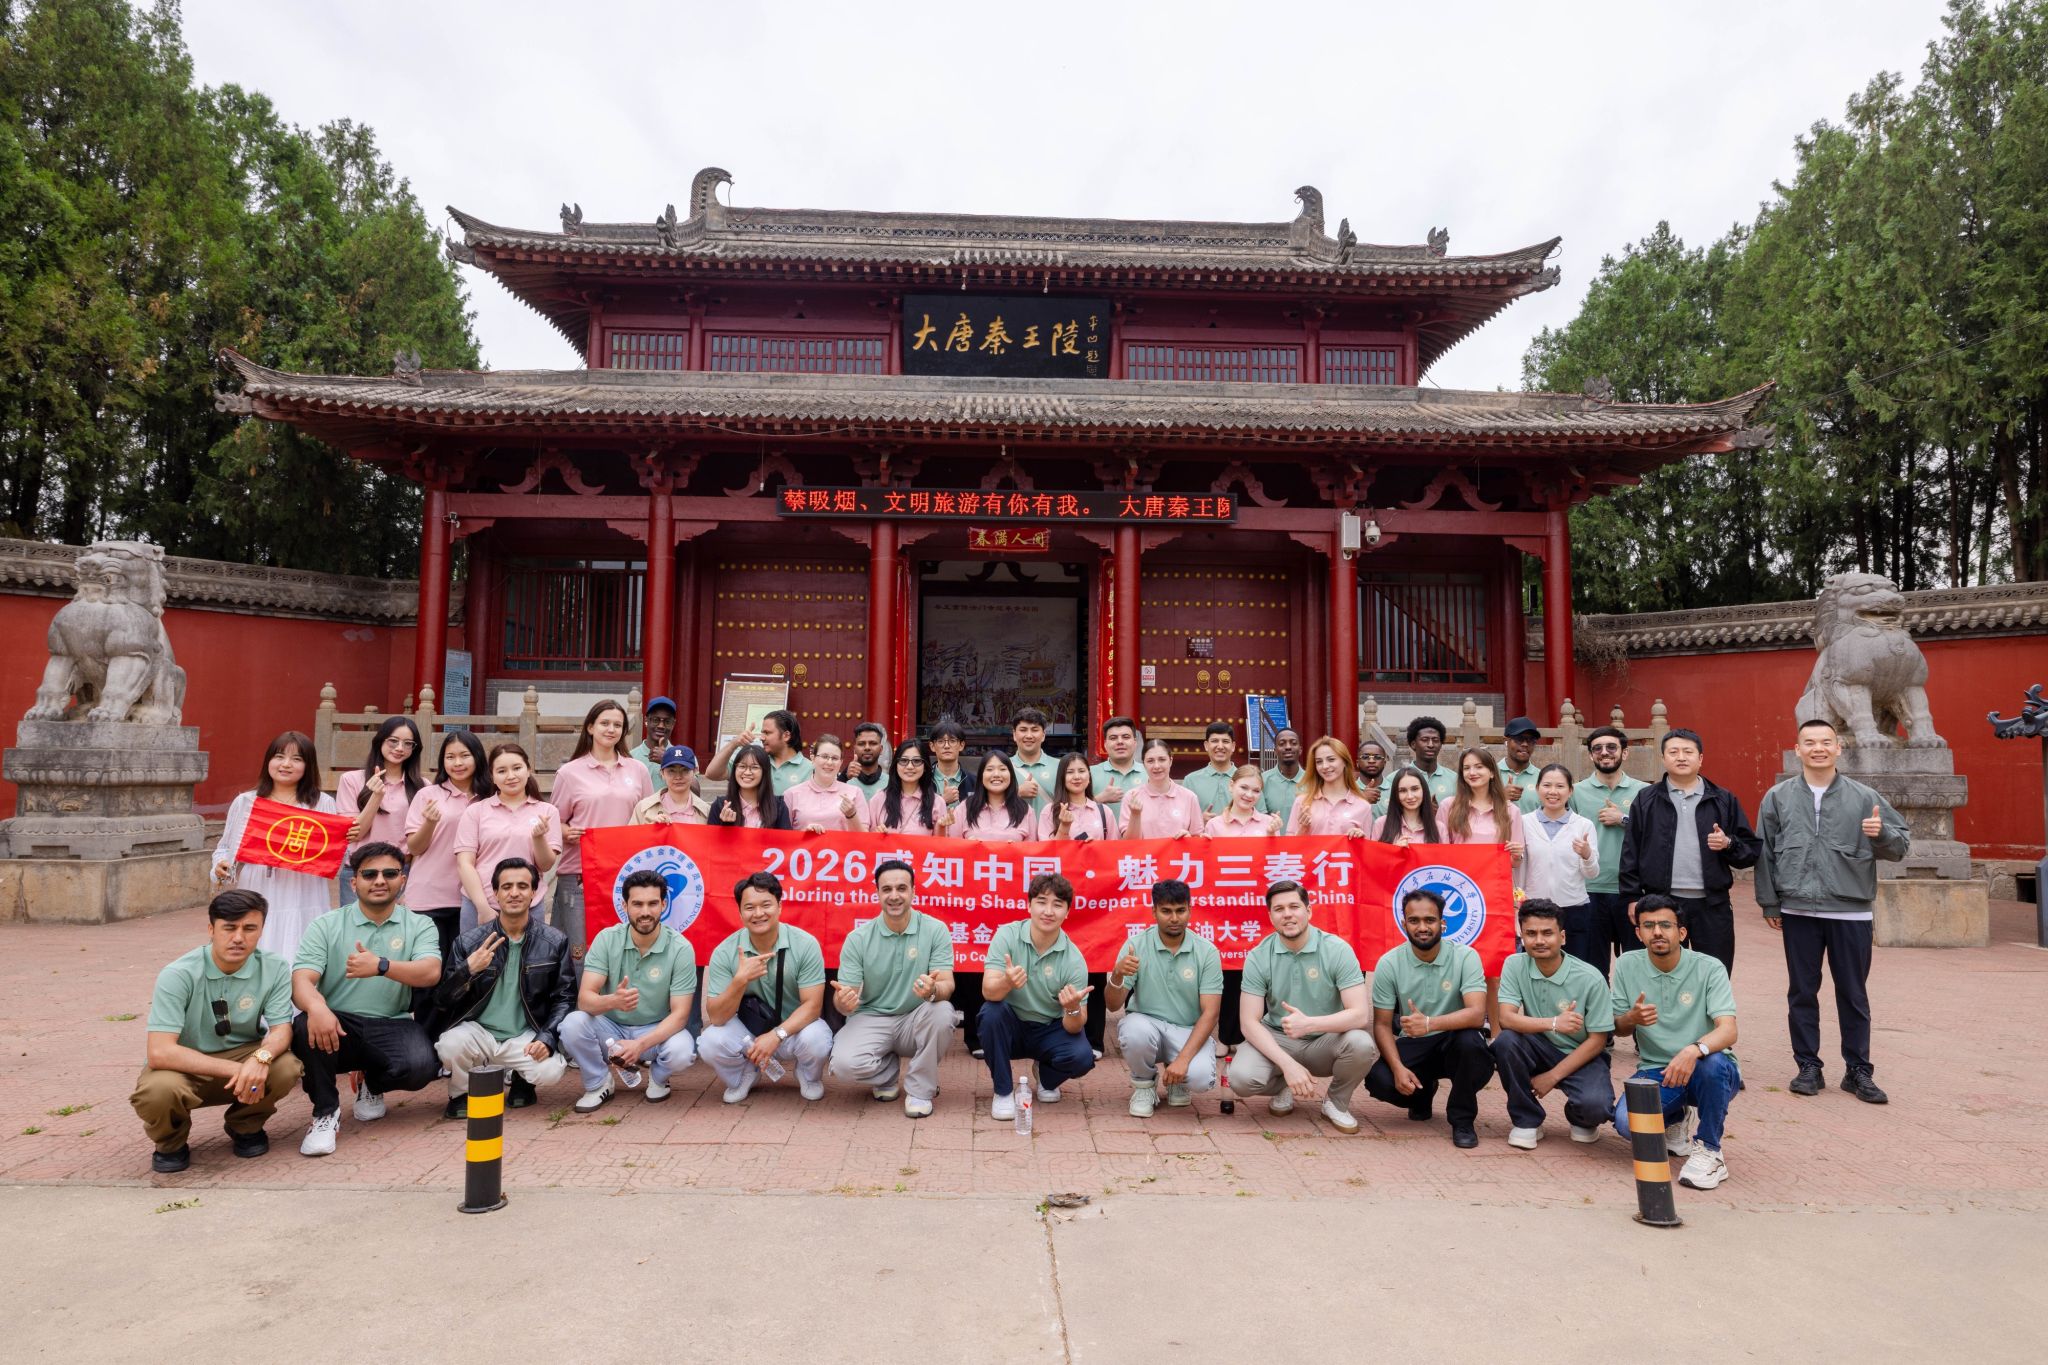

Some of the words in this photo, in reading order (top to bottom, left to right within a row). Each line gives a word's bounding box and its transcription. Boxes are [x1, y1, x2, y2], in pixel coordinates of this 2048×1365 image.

[912, 312, 1080, 357] 大唐秦王陵
[674, 749, 683, 757] R
[850, 888, 879, 904] the
[911, 892, 976, 911] arming
[1075, 895, 1137, 911] Deeper
[1308, 889, 1354, 905] China
[1451, 909, 1478, 943] NIVERSITY
